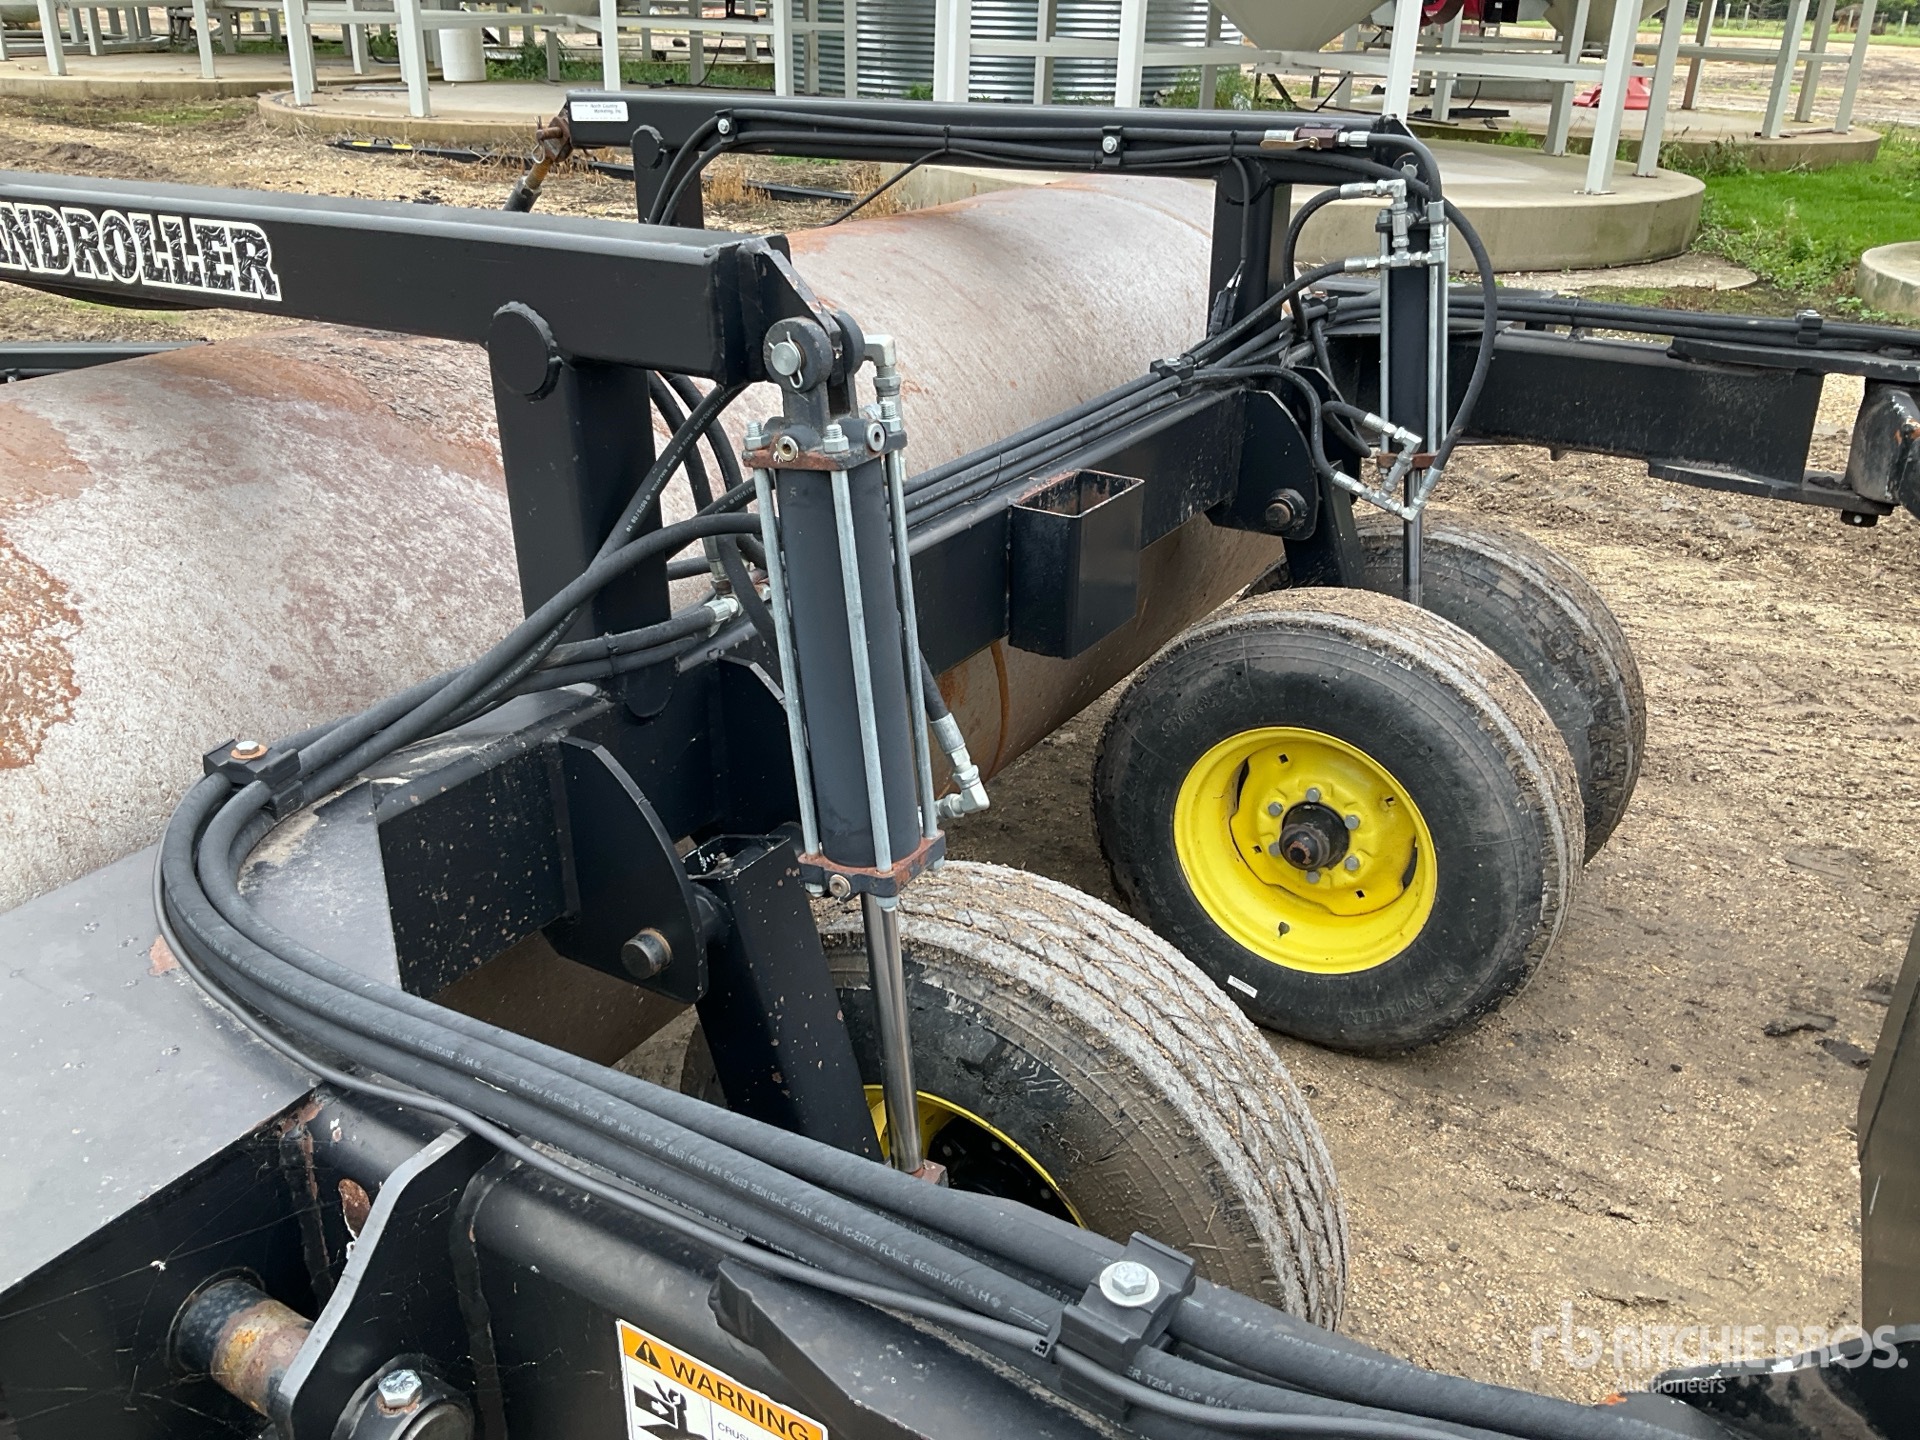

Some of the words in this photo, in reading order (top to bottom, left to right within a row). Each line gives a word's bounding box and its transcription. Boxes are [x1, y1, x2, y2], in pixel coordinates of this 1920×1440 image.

[0, 202, 282, 301] NDROLLER
[813, 1212, 841, 1231] MSHA
[877, 1242, 911, 1265] FLAME
[911, 1258, 965, 1290] RESISTANT
[669, 1356, 810, 1440] WARNING
[718, 1422, 749, 1440] CRUS
